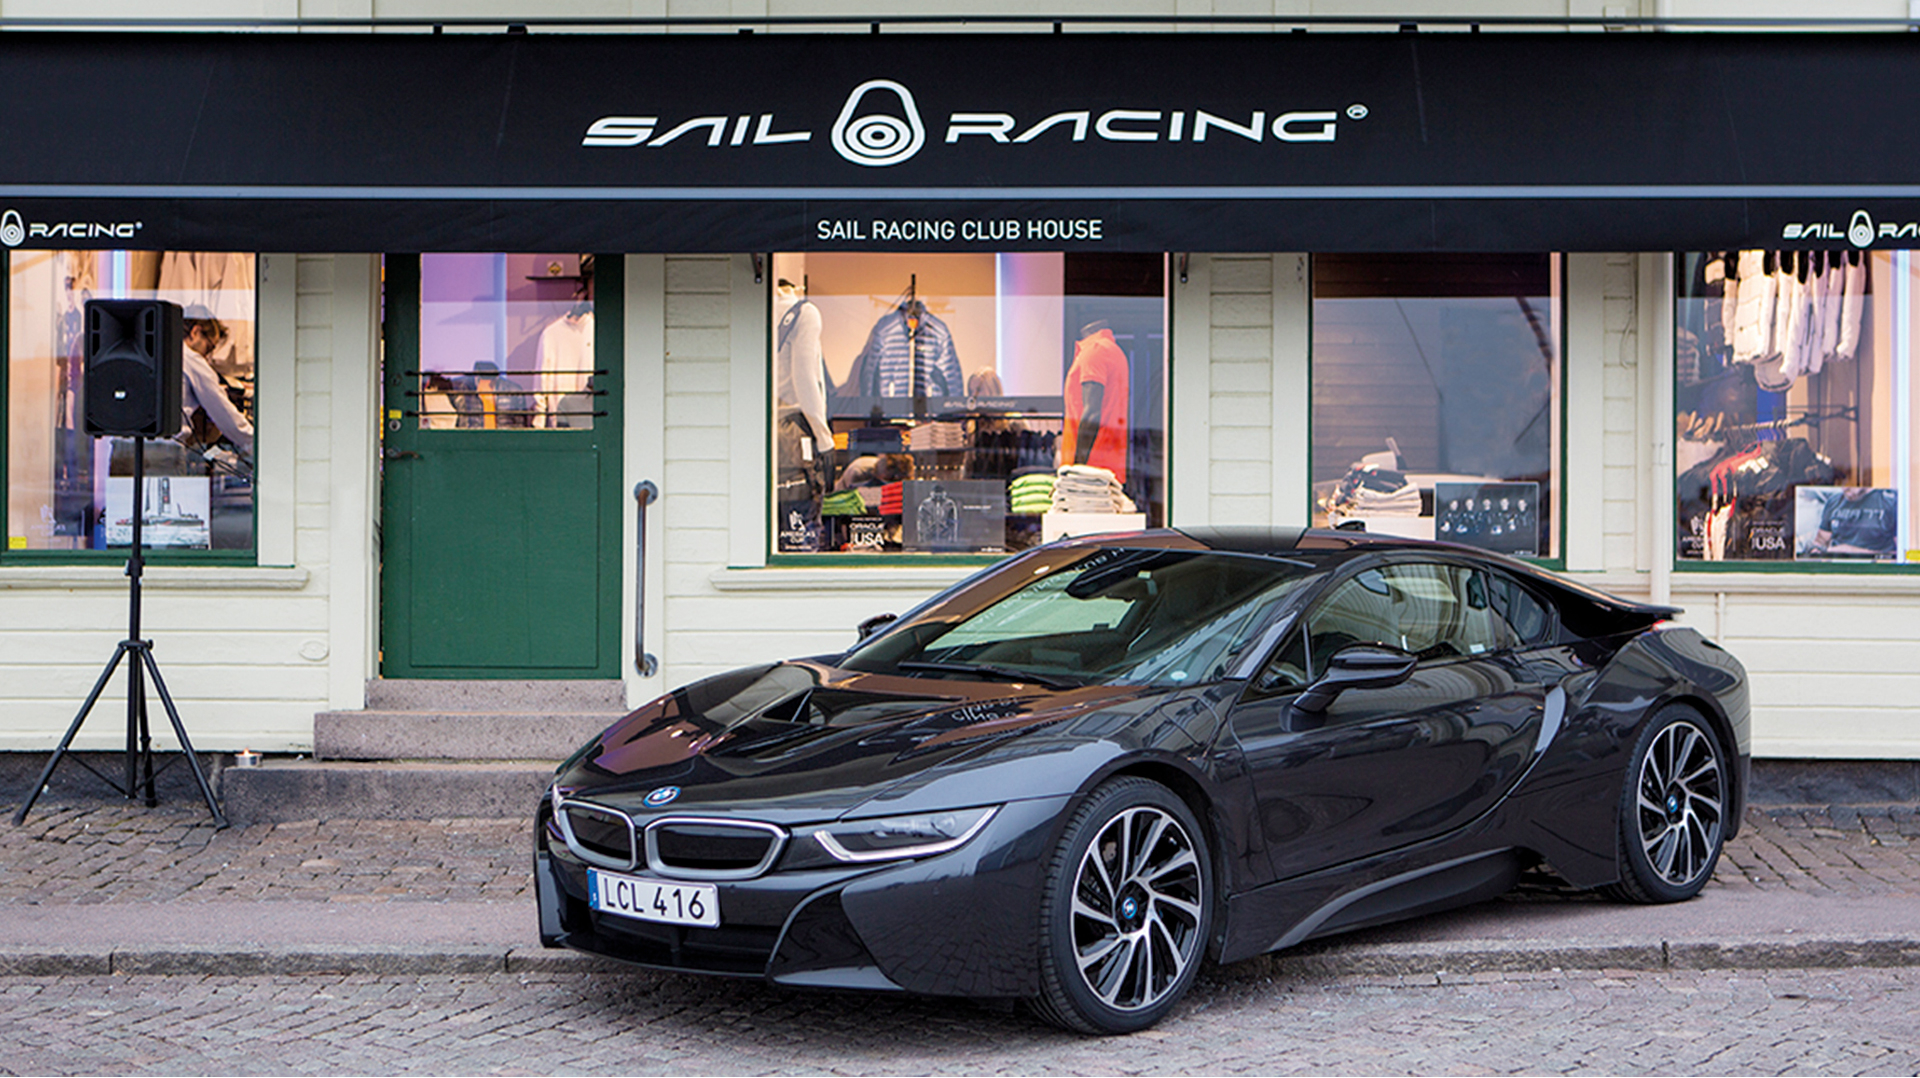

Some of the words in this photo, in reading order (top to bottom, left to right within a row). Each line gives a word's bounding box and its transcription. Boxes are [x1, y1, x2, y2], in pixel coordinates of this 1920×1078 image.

[581, 113, 812, 147] SAIL
[944, 109, 1338, 143] RACING
[29, 222, 135, 238] RACING
[816, 220, 866, 240] SAIL
[872, 220, 956, 240] RACING
[961, 220, 1021, 240] CLUB
[1027, 219, 1103, 240] HOUSE
[1782, 223, 1845, 239] SAIL
[1878, 222, 1920, 239] RA
[854, 531, 885, 546] USA
[1755, 536, 1786, 550] USA
[603, 877, 645, 913] LCL
[653, 886, 705, 919] 416
